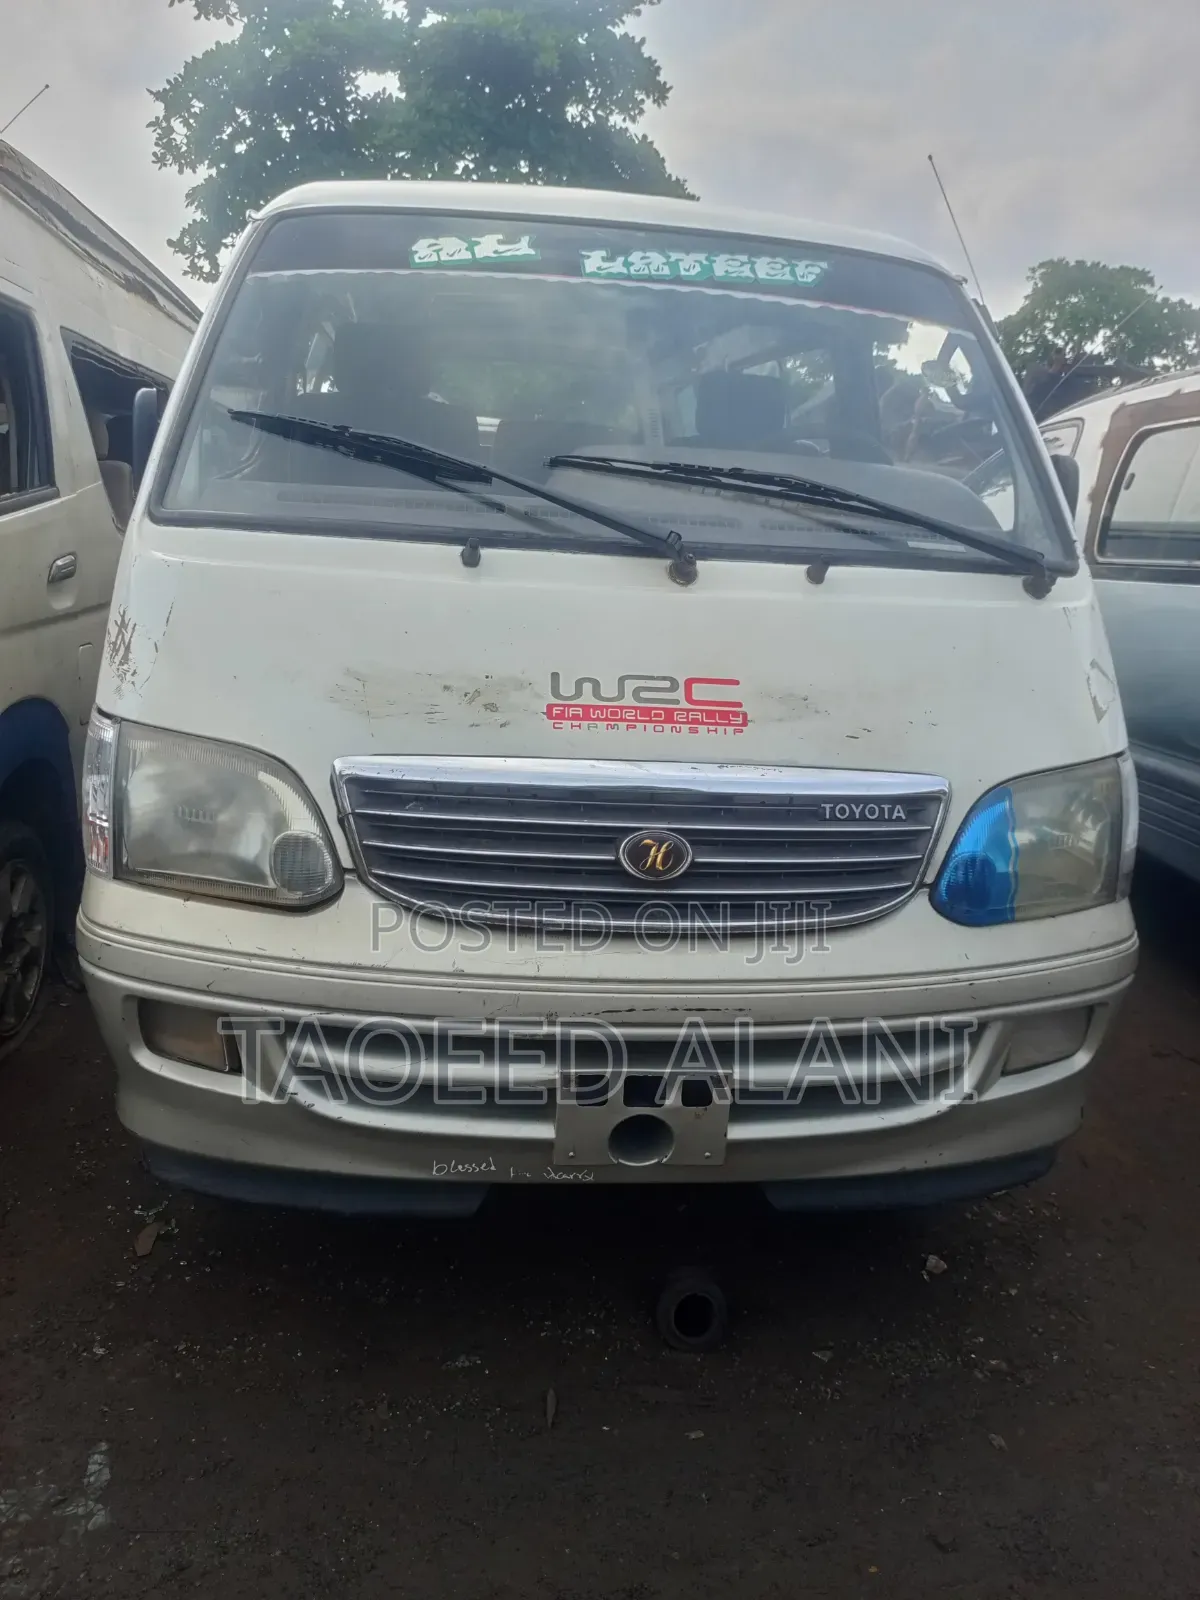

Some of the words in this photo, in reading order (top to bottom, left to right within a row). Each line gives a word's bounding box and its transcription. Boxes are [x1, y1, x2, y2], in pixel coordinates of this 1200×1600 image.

[580, 249, 829, 286] LATEEF
[550, 671, 744, 708] WRC
[552, 707, 583, 719] FIA
[590, 708, 665, 721] WORLD
[674, 711, 743, 724] RALLY
[552, 721, 744, 736] CHAMPIONSHIP
[820, 803, 907, 820] TOYOTA
